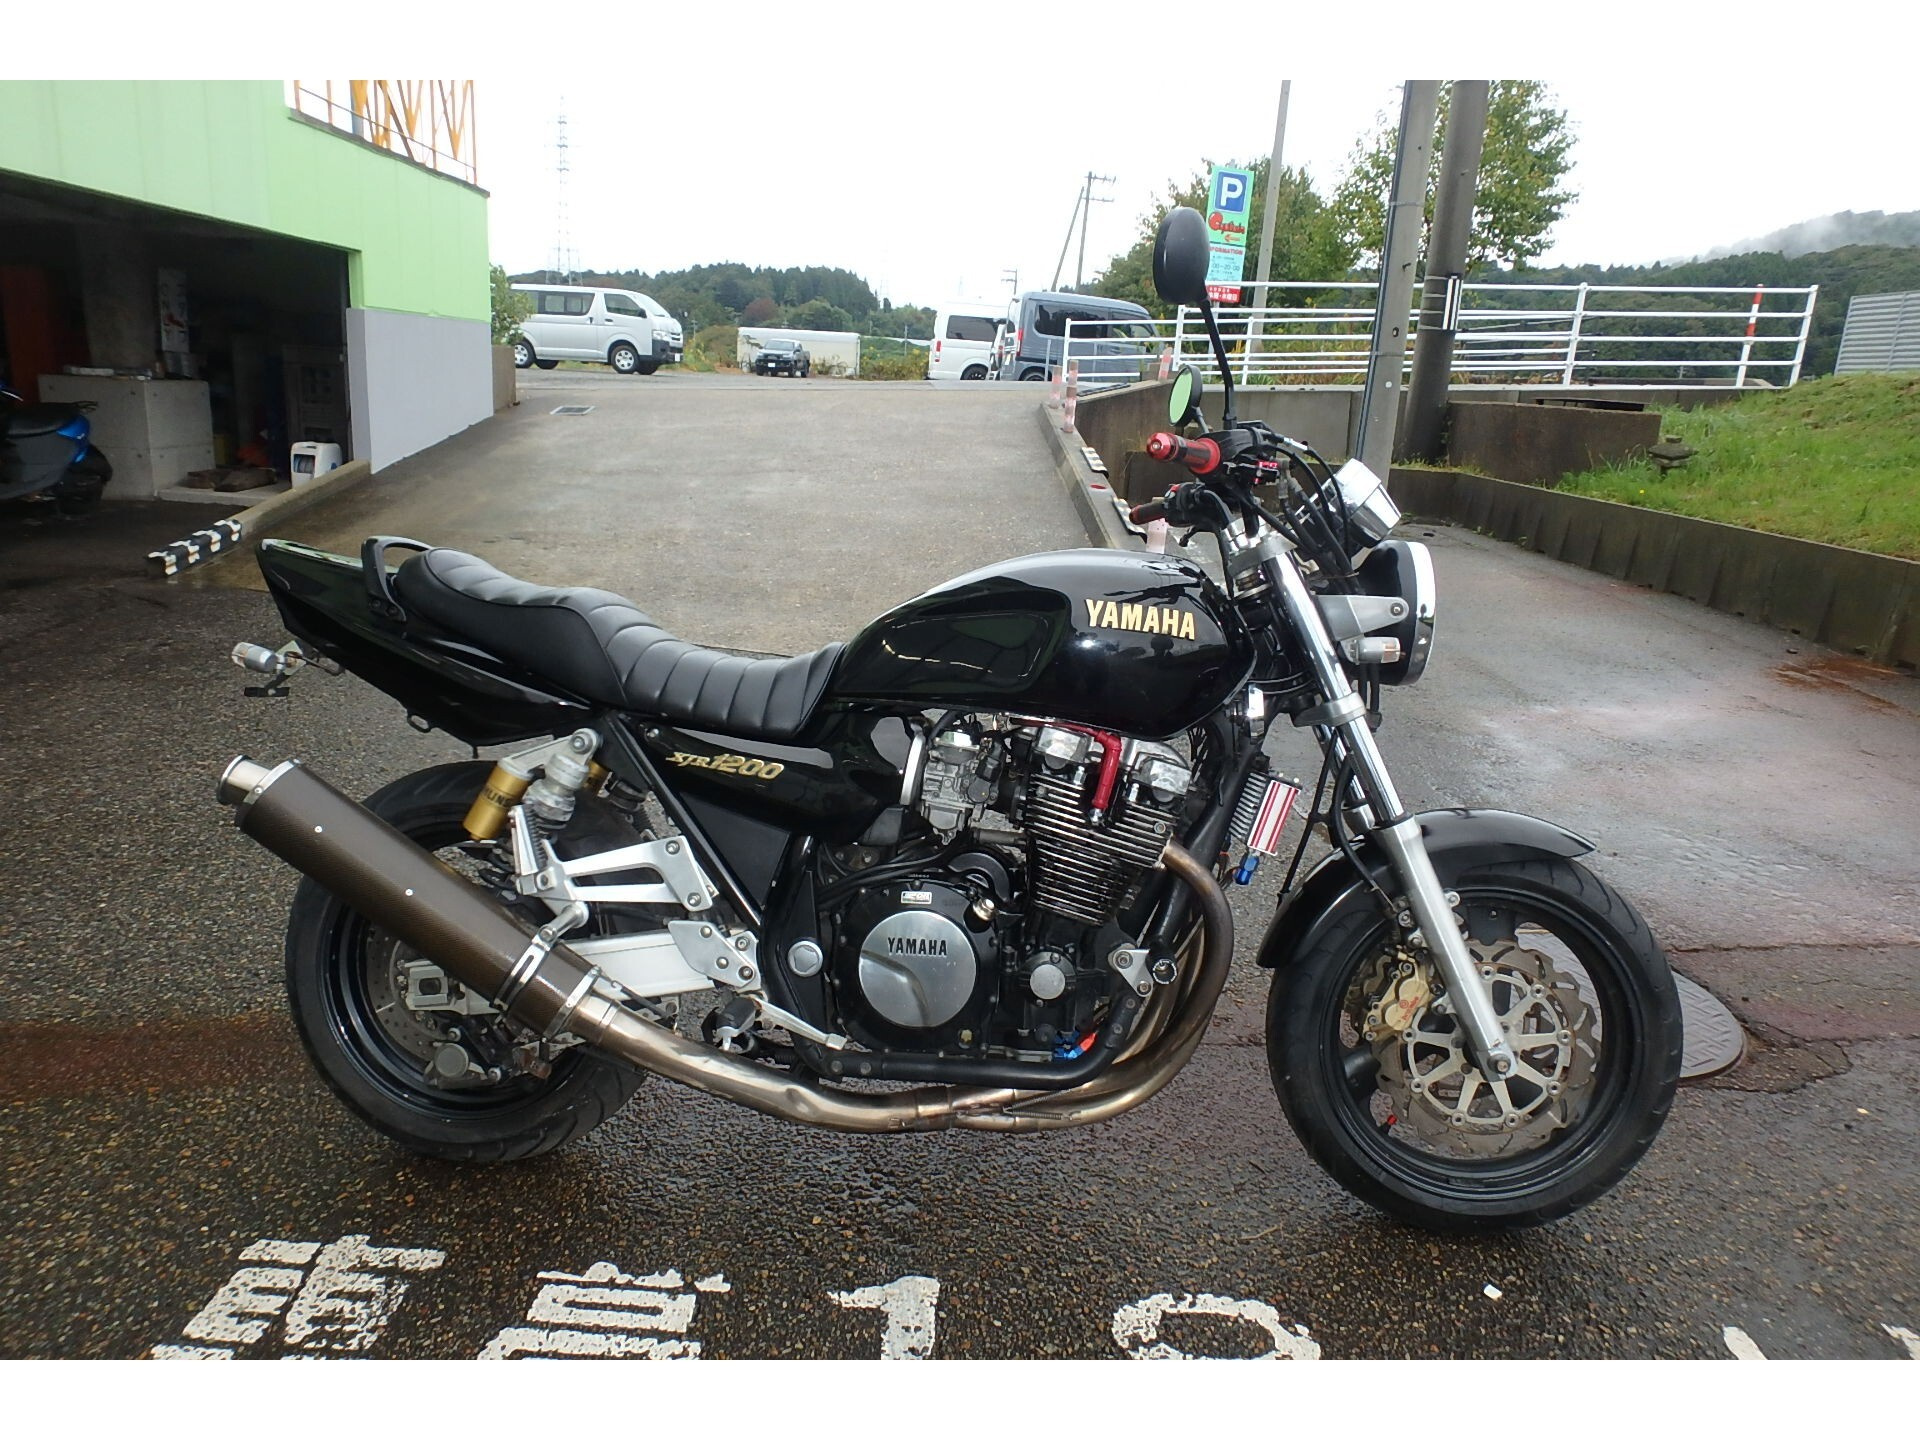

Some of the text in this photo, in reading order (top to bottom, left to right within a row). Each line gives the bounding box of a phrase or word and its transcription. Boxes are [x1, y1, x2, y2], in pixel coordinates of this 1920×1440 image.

[1220, 176, 1243, 207] P
[1084, 598, 1196, 641] YAMAHA
[887, 936, 948, 957] YAMAHA
